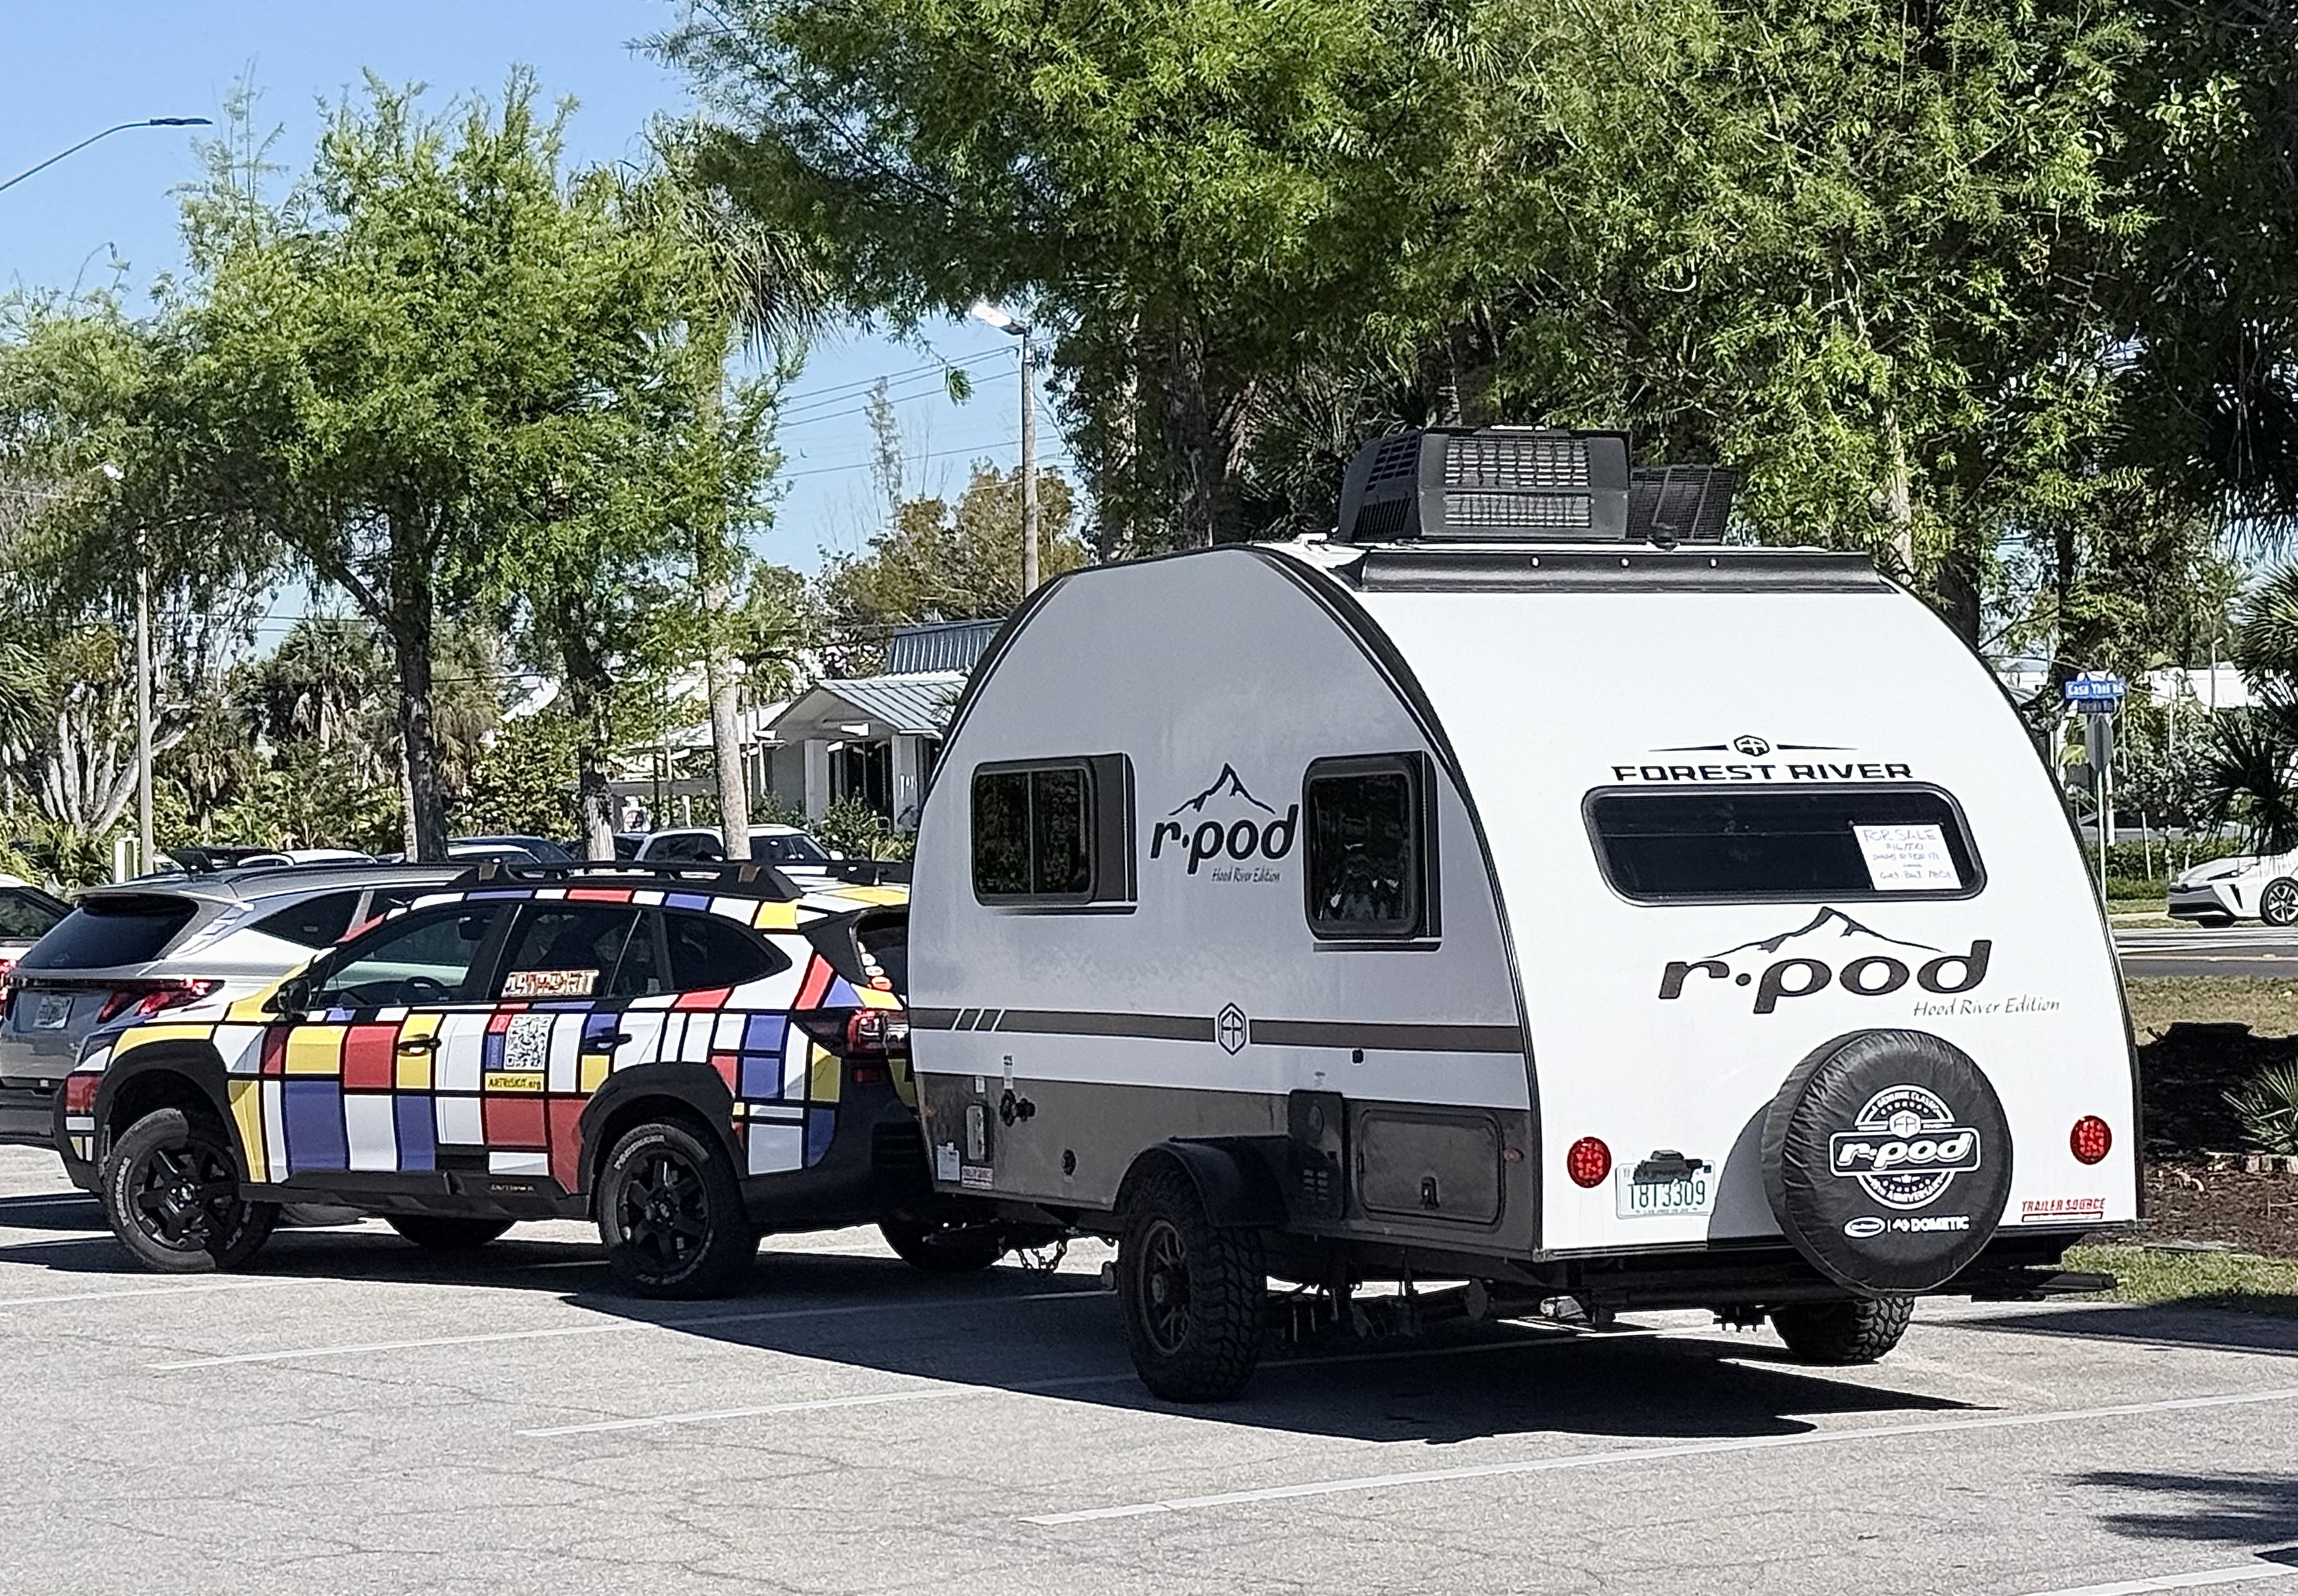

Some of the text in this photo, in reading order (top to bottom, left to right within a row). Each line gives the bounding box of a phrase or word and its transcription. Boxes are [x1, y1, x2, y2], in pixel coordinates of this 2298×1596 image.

[1611, 764, 1914, 781] FOREST RIVER
[1862, 829, 1893, 842] FOR
[1913, 994, 2061, 1017] Hood River Edition
[2021, 1197, 2106, 1212] TRAILER SOURCE
